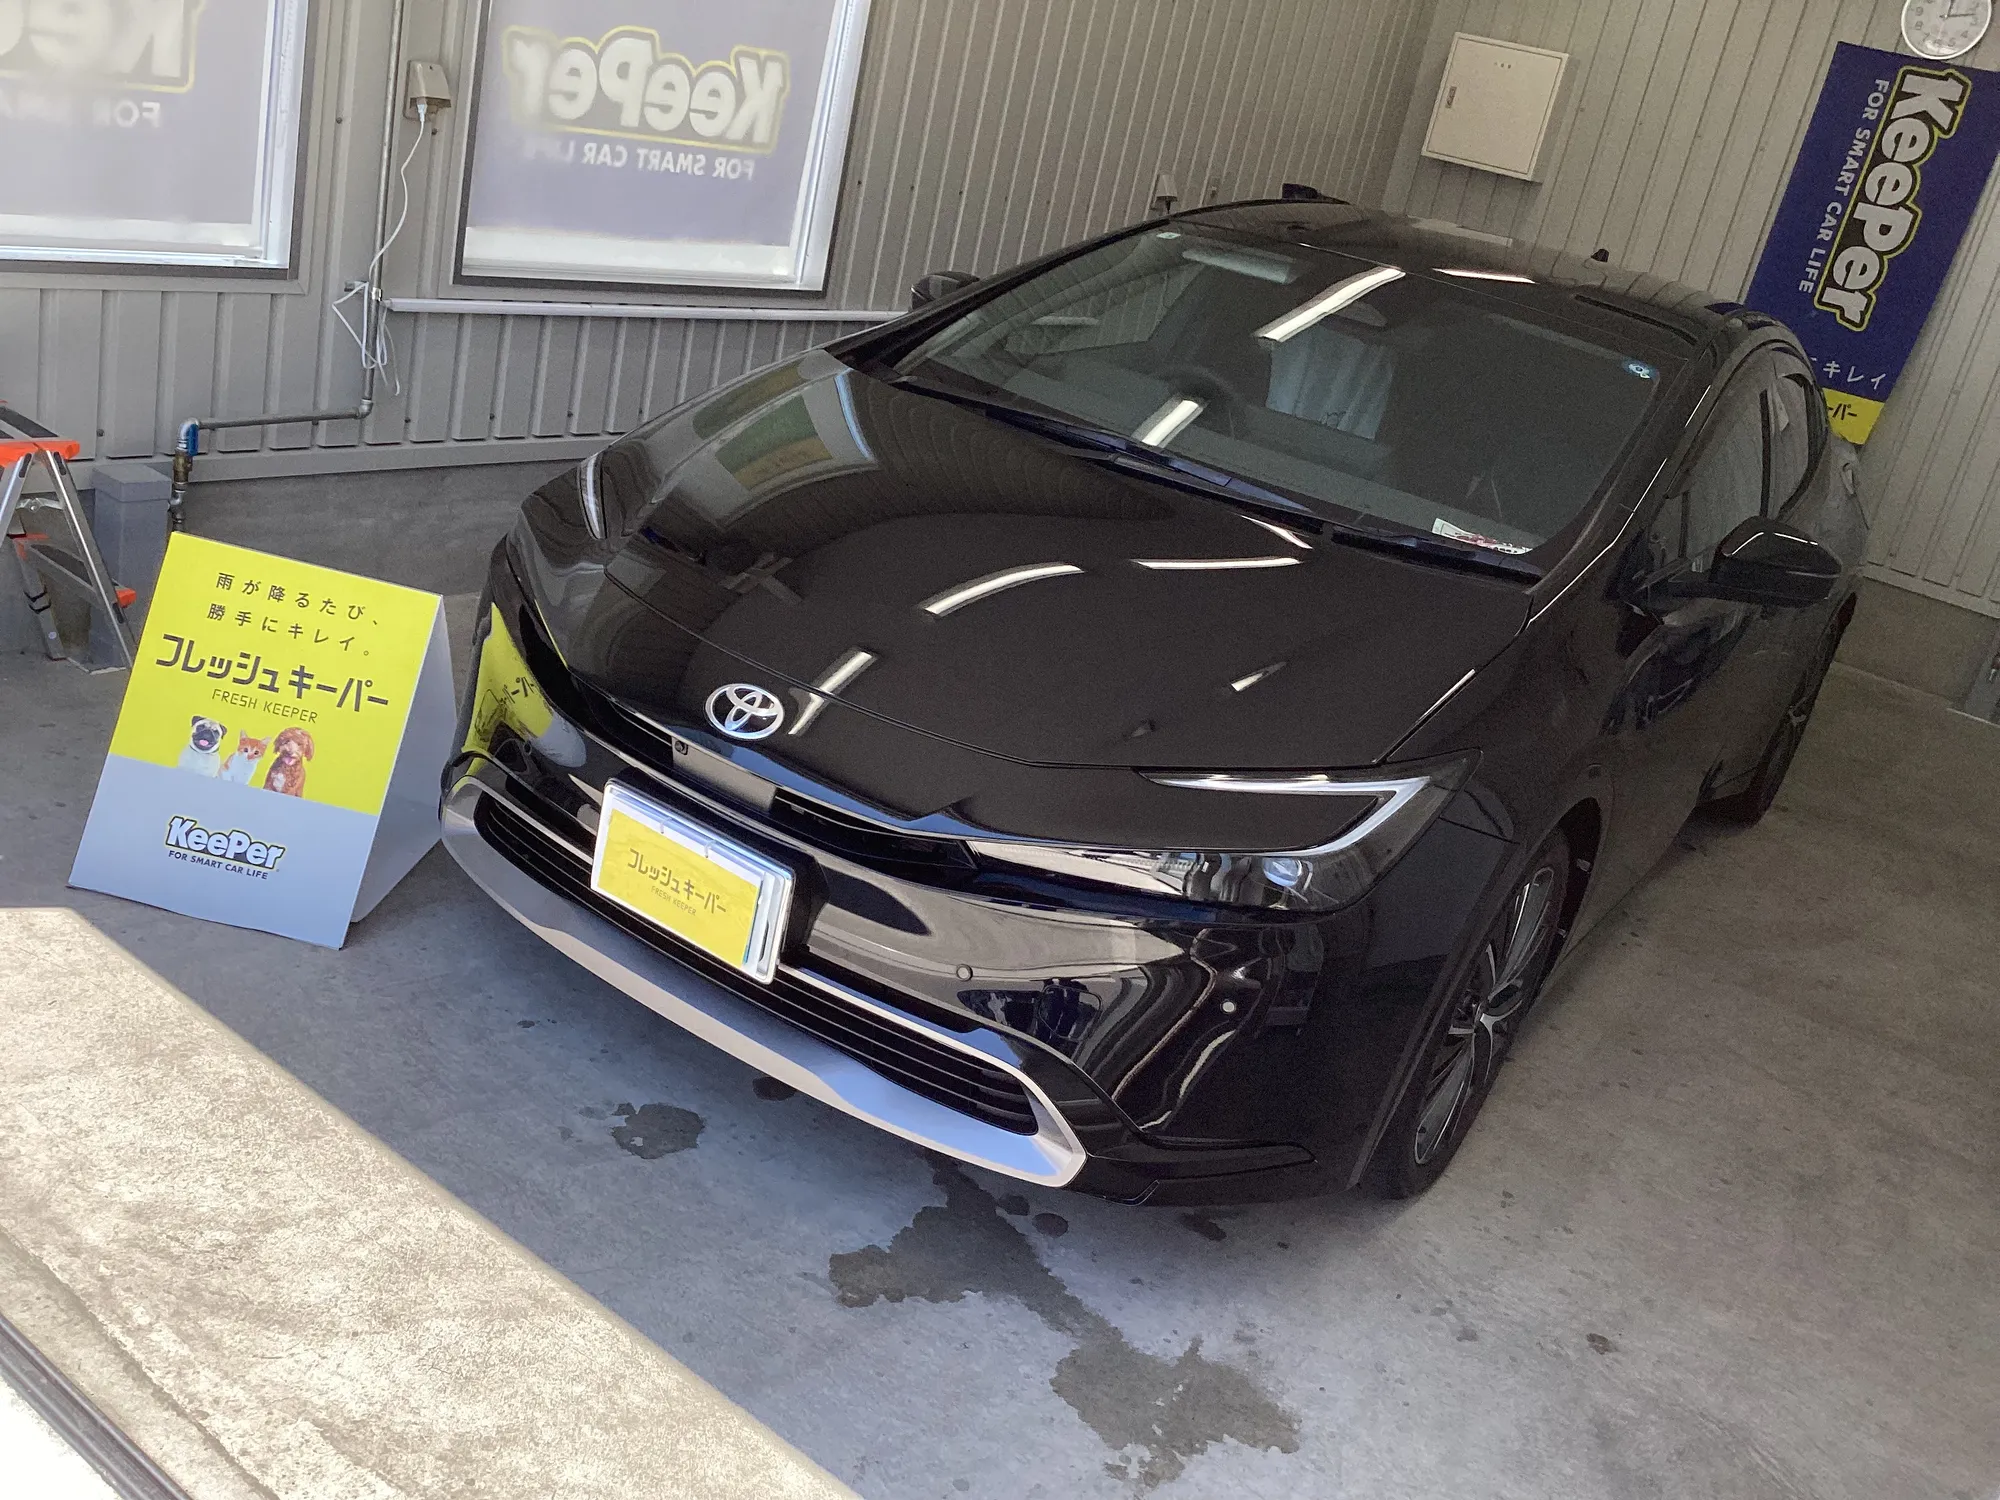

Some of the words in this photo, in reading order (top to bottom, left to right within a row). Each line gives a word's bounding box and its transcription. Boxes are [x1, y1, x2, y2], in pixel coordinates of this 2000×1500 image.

[1862, 79, 1890, 121] FOR
[1834, 127, 1871, 197] SMART
[1816, 68, 1970, 330] KeePer
[1816, 201, 1842, 241] CAR
[1798, 247, 1826, 293] LIFE
[1810, 357, 1887, 390] キレイ
[215, 572, 378, 626] 雨が降るたび、
[207, 603, 370, 656] 勝手にキレイ。
[155, 633, 389, 712] フレッシュキーパー
[211, 688, 258, 709] FRESH
[263, 701, 319, 724] KEEPER
[165, 815, 286, 870] KeePer
[168, 850, 188, 861] FOR
[190, 855, 223, 869] SMART
[225, 863, 243, 874] CAR
[246, 868, 268, 880] LIFE
[627, 847, 727, 914] フレッシュキーパー
[651, 885, 672, 902] FRESH
[673, 898, 697, 916] KEEPER
